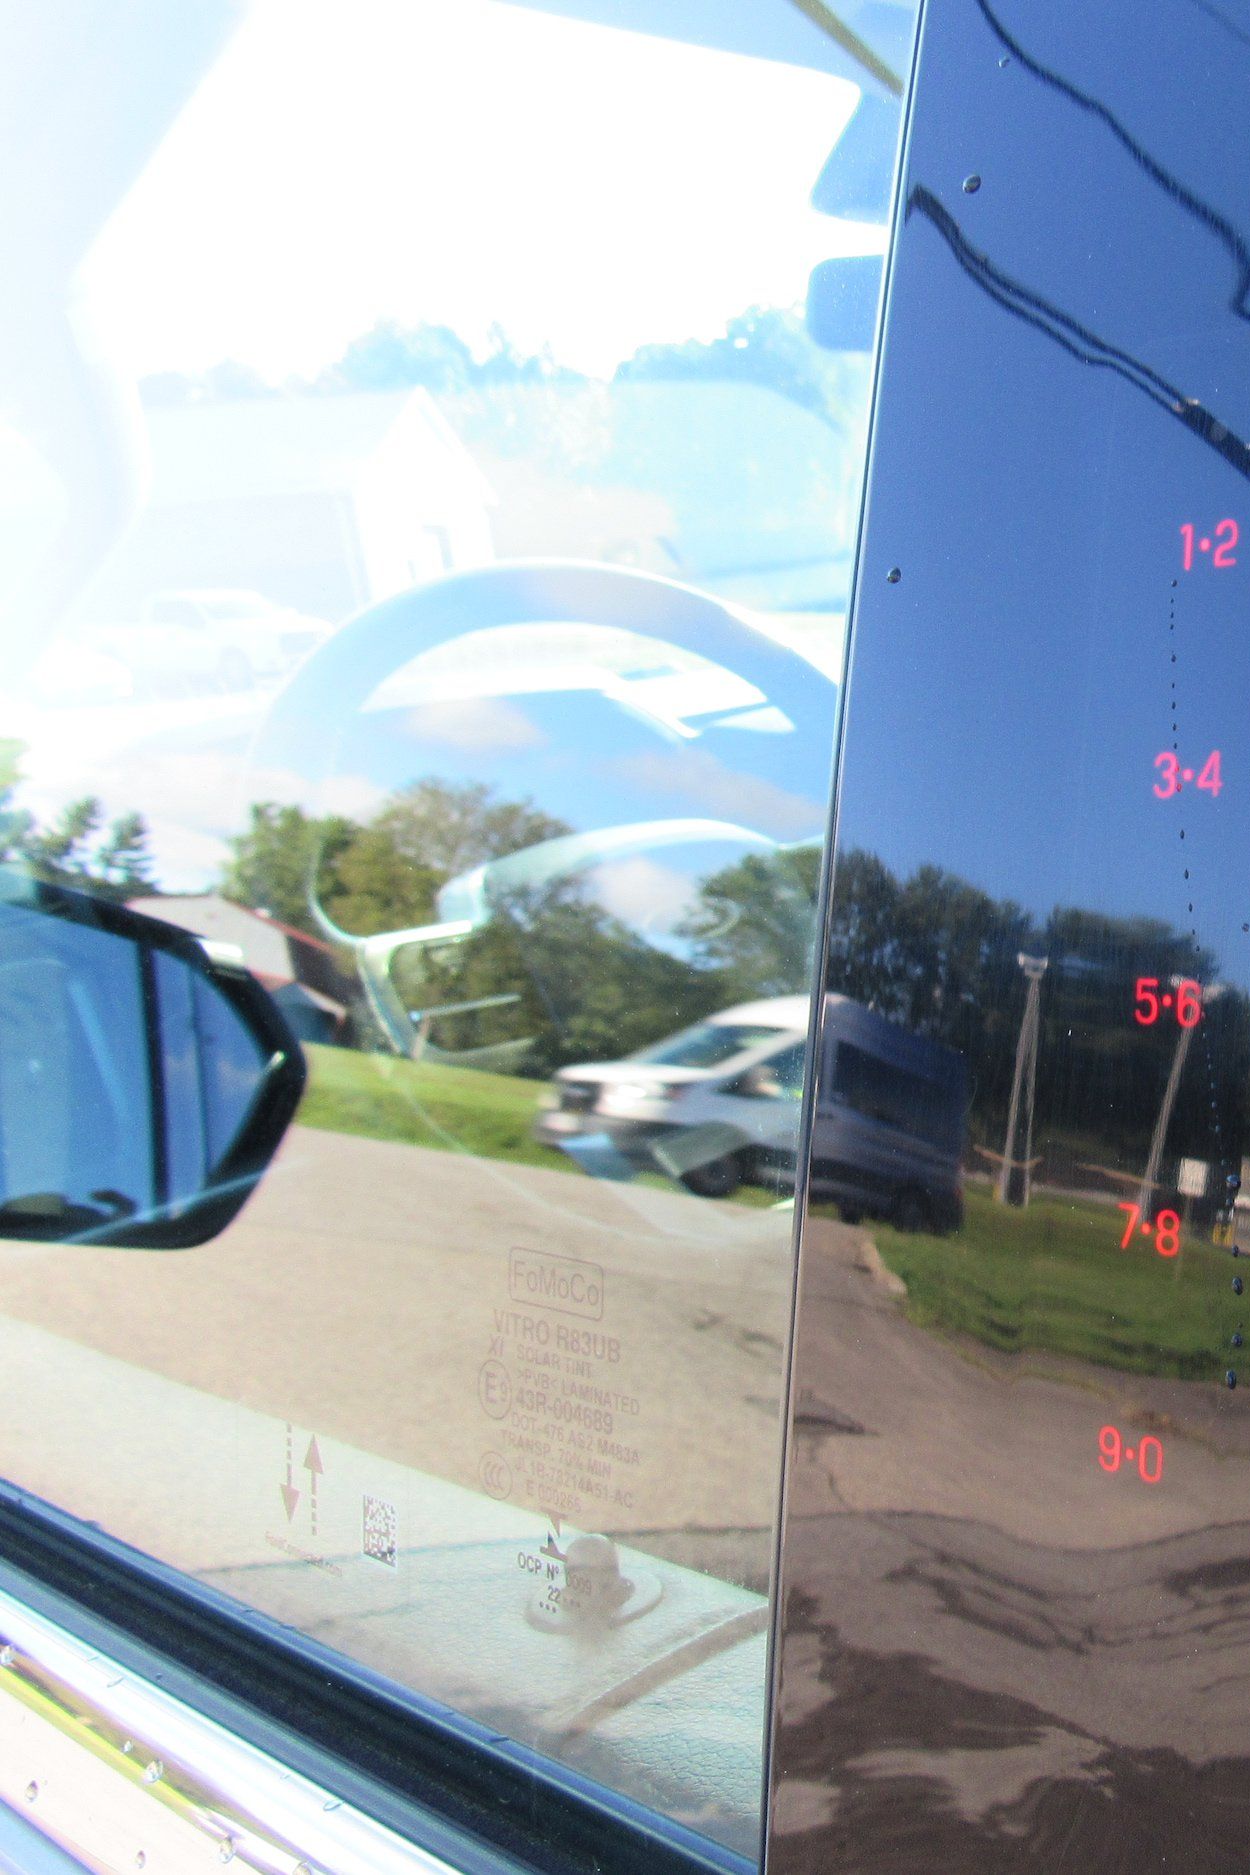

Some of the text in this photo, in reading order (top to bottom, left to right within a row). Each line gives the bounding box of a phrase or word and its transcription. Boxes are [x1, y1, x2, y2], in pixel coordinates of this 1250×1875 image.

[514, 1260, 599, 1306] FoMoCo
[494, 1309, 549, 1346] VITRO
[516, 1343, 592, 1379] SOLAR TINT
[561, 1379, 640, 1416] LAMINATED
[588, 1458, 611, 1480] MIN
[518, 1552, 541, 1574] OCP
